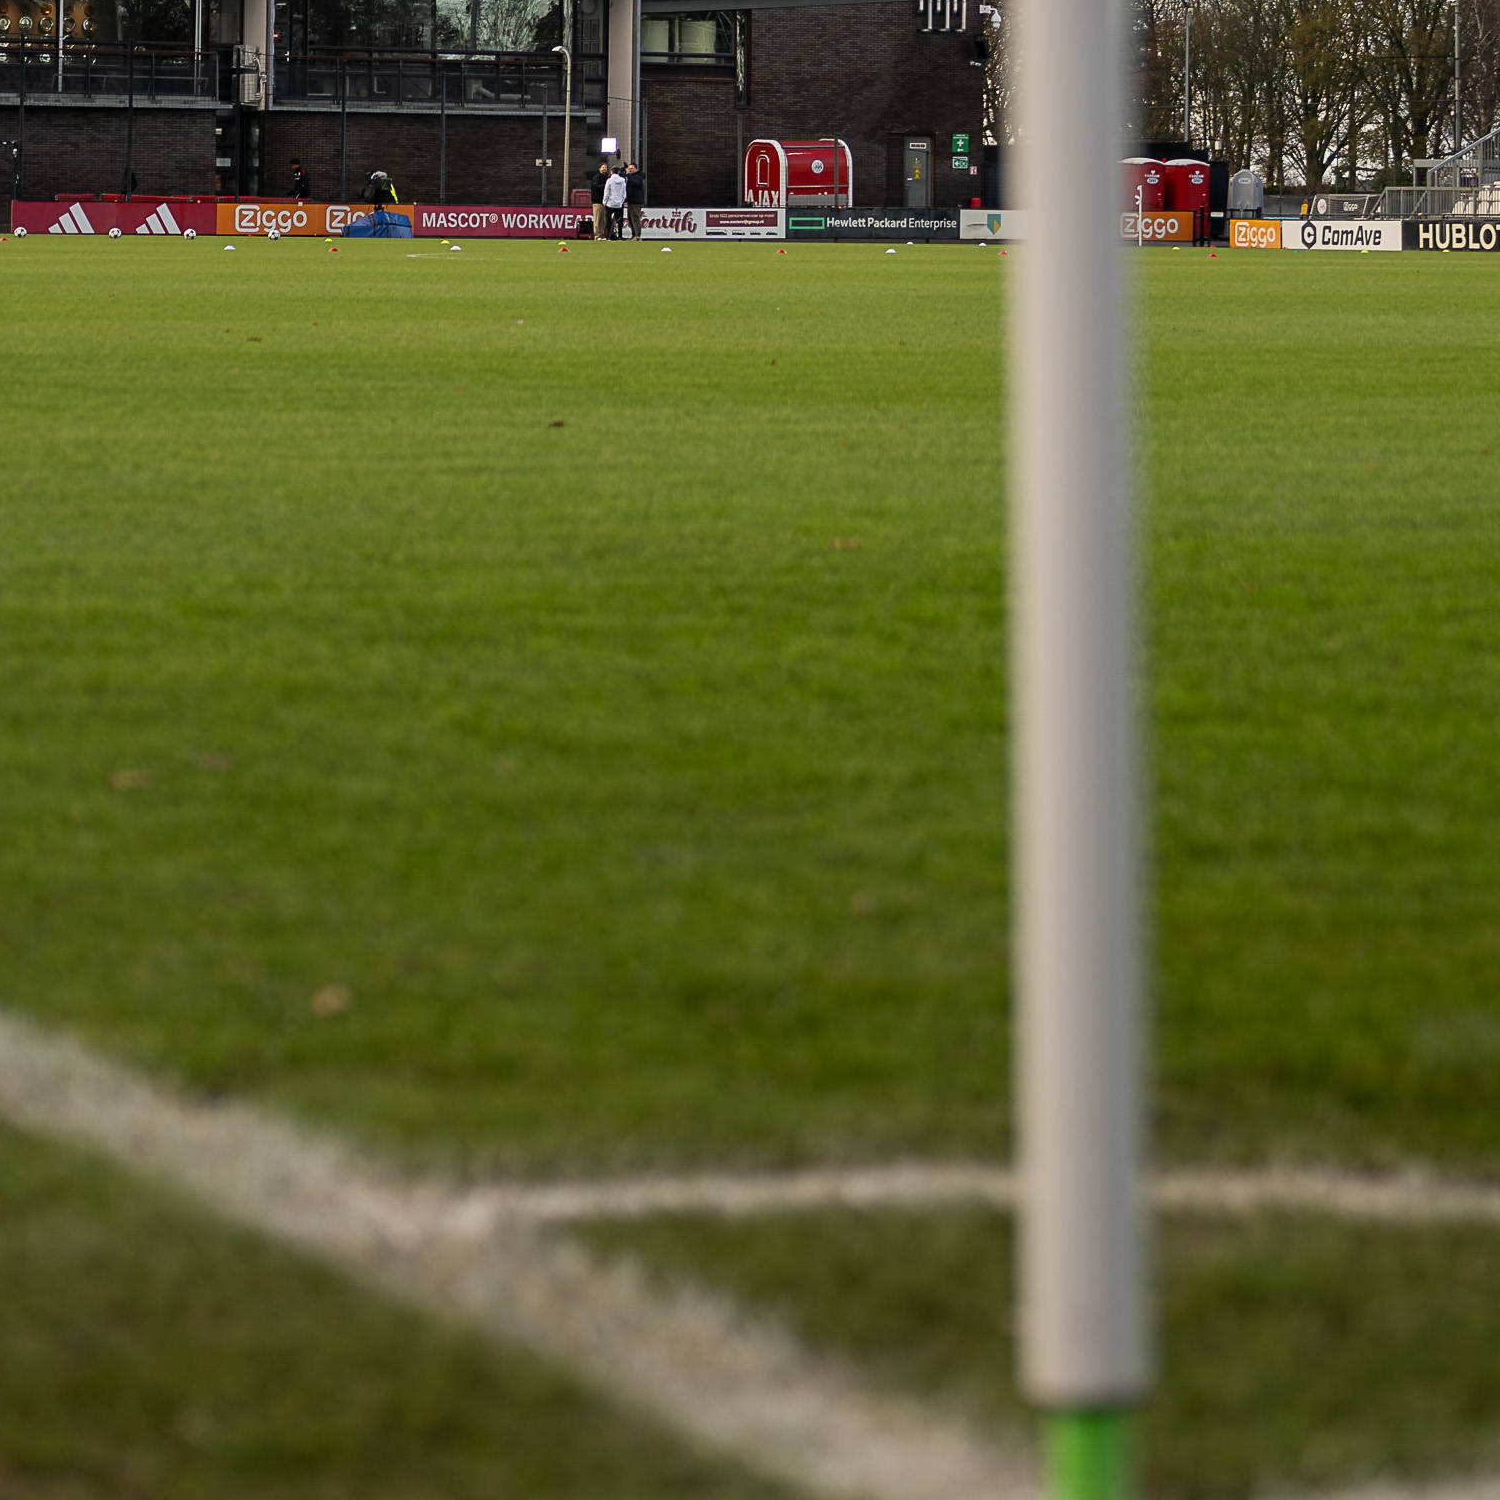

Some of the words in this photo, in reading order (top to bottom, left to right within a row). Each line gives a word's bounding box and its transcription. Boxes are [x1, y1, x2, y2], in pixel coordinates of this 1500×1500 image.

[747, 189, 779, 207] AJAX
[826, 217, 866, 228] Hewlett
[868, 217, 906, 228] Packard
[909, 218, 957, 230] Enterprise
[1321, 225, 1382, 246] ComAve
